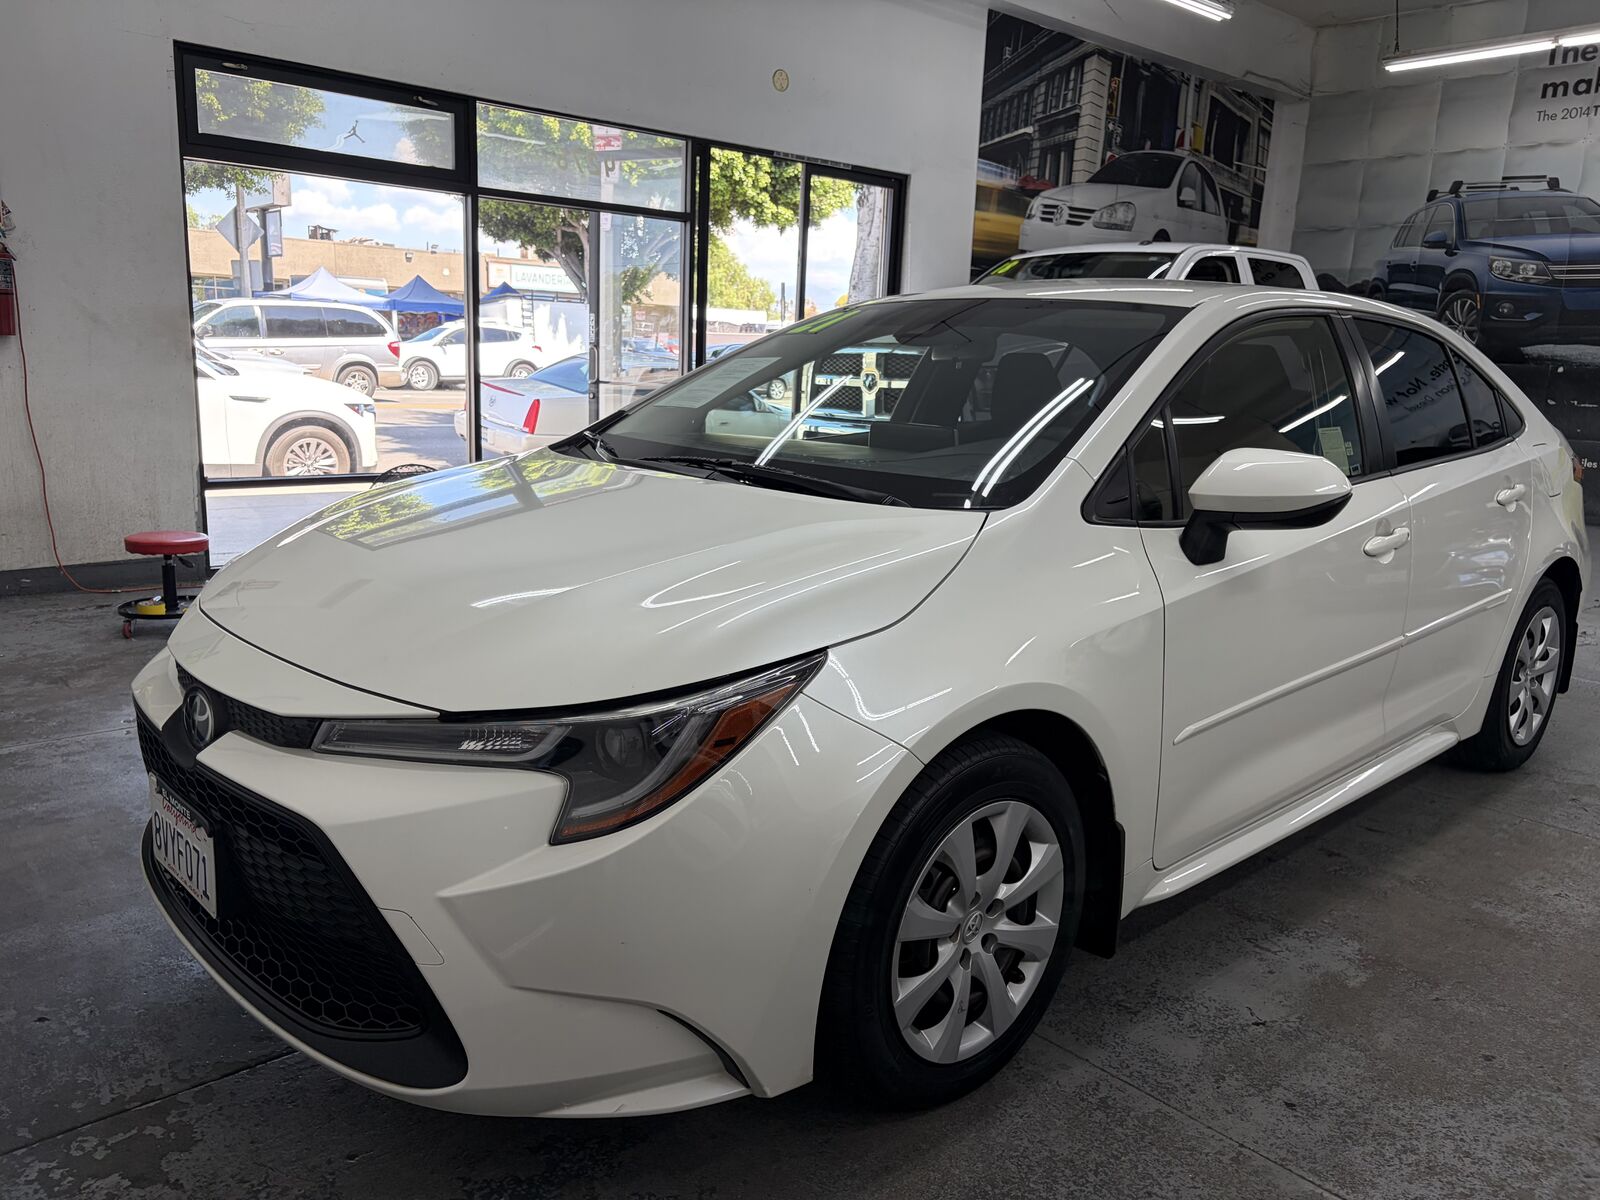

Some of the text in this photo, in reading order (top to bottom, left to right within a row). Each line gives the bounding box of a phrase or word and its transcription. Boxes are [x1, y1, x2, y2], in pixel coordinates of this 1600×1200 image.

[1536, 109, 1558, 122] The
[1561, 106, 1591, 120] 2014
[153, 810, 210, 902] 8VYF071
